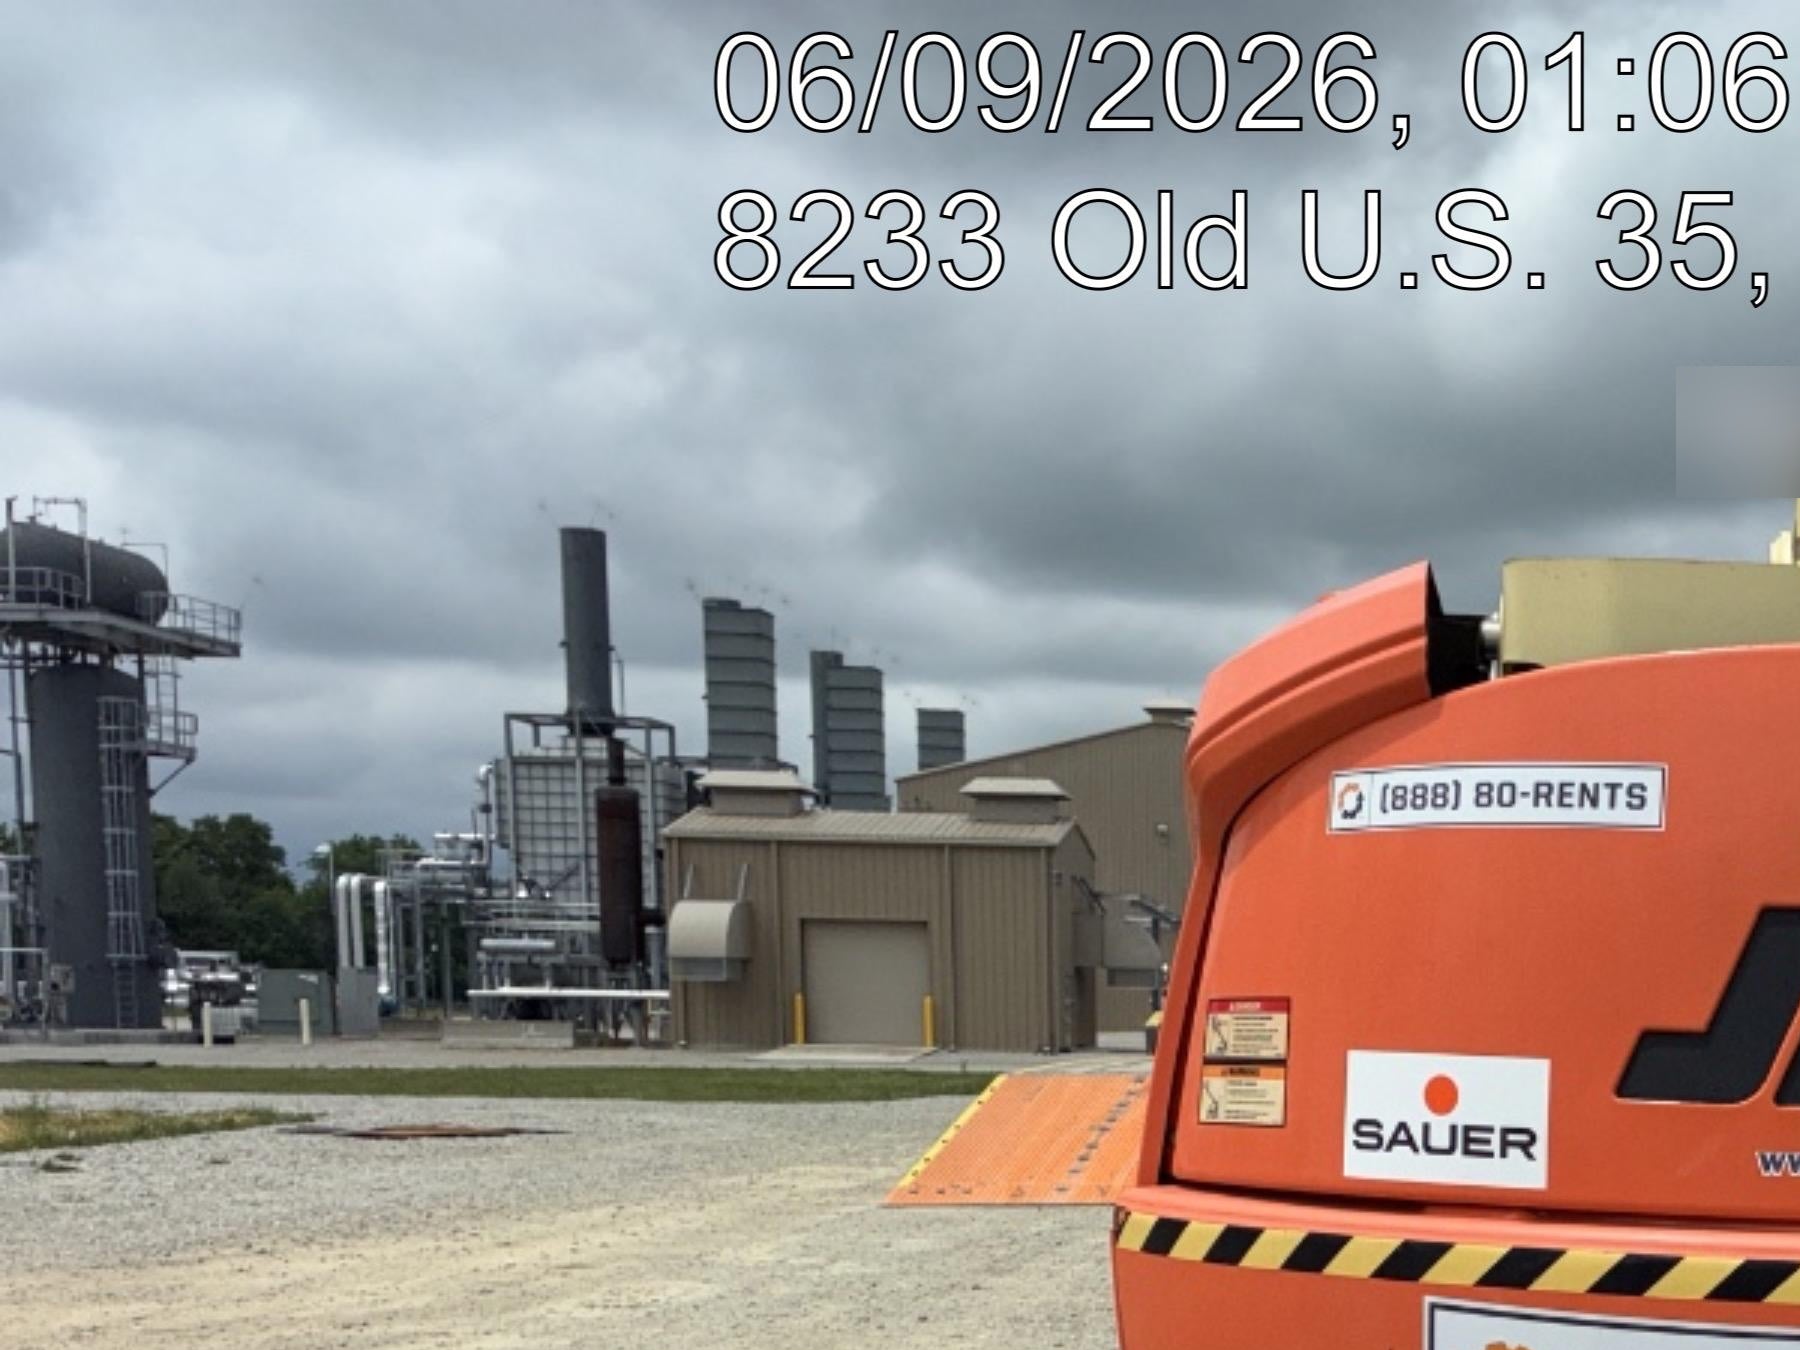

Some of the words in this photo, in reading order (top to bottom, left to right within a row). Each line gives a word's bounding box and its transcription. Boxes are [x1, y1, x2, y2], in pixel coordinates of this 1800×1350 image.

[1379, 780, 1461, 813] (888)
[1473, 782, 1648, 809] 80-RENTS
[1352, 1120, 1538, 1160] SAUER
